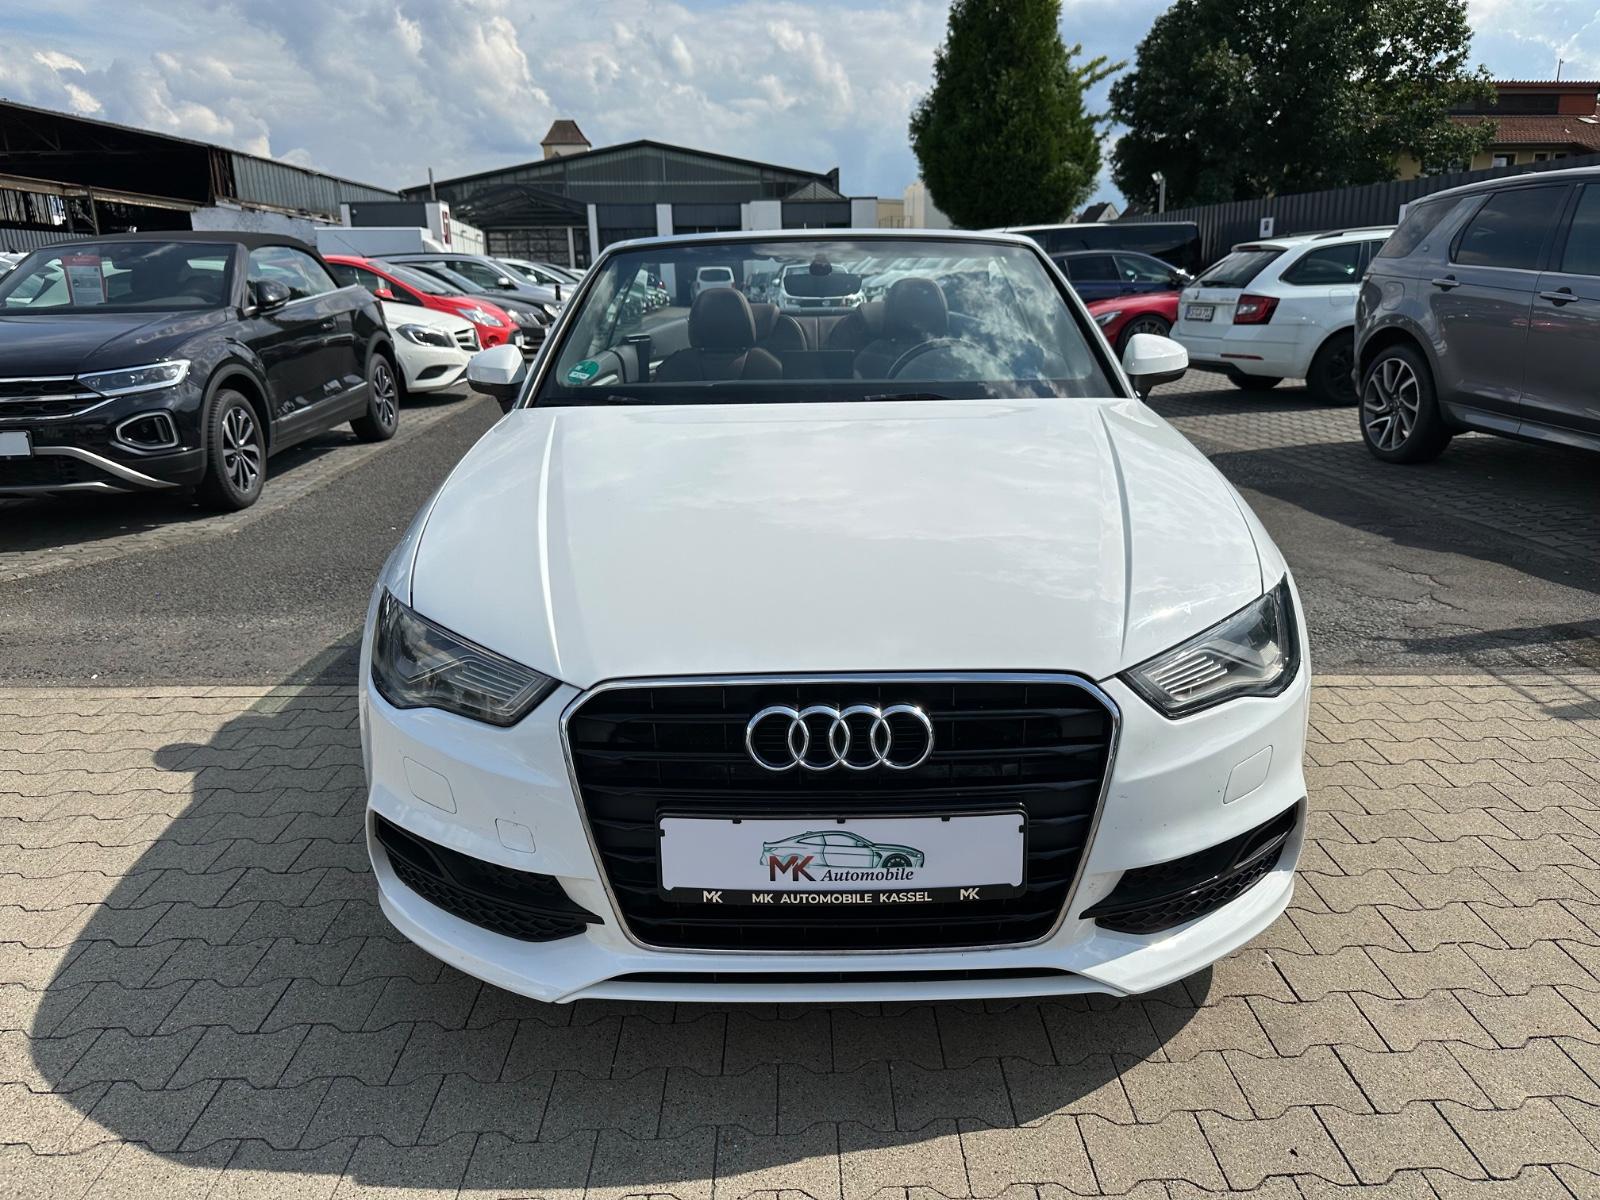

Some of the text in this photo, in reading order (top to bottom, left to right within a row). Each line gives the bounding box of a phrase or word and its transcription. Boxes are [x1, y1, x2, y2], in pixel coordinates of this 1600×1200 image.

[769, 855, 914, 882] MK Automobile
[702, 890, 723, 904] MK
[751, 891, 932, 904] MK AUTOMOBILE KASSEL
[959, 888, 980, 901] MK
